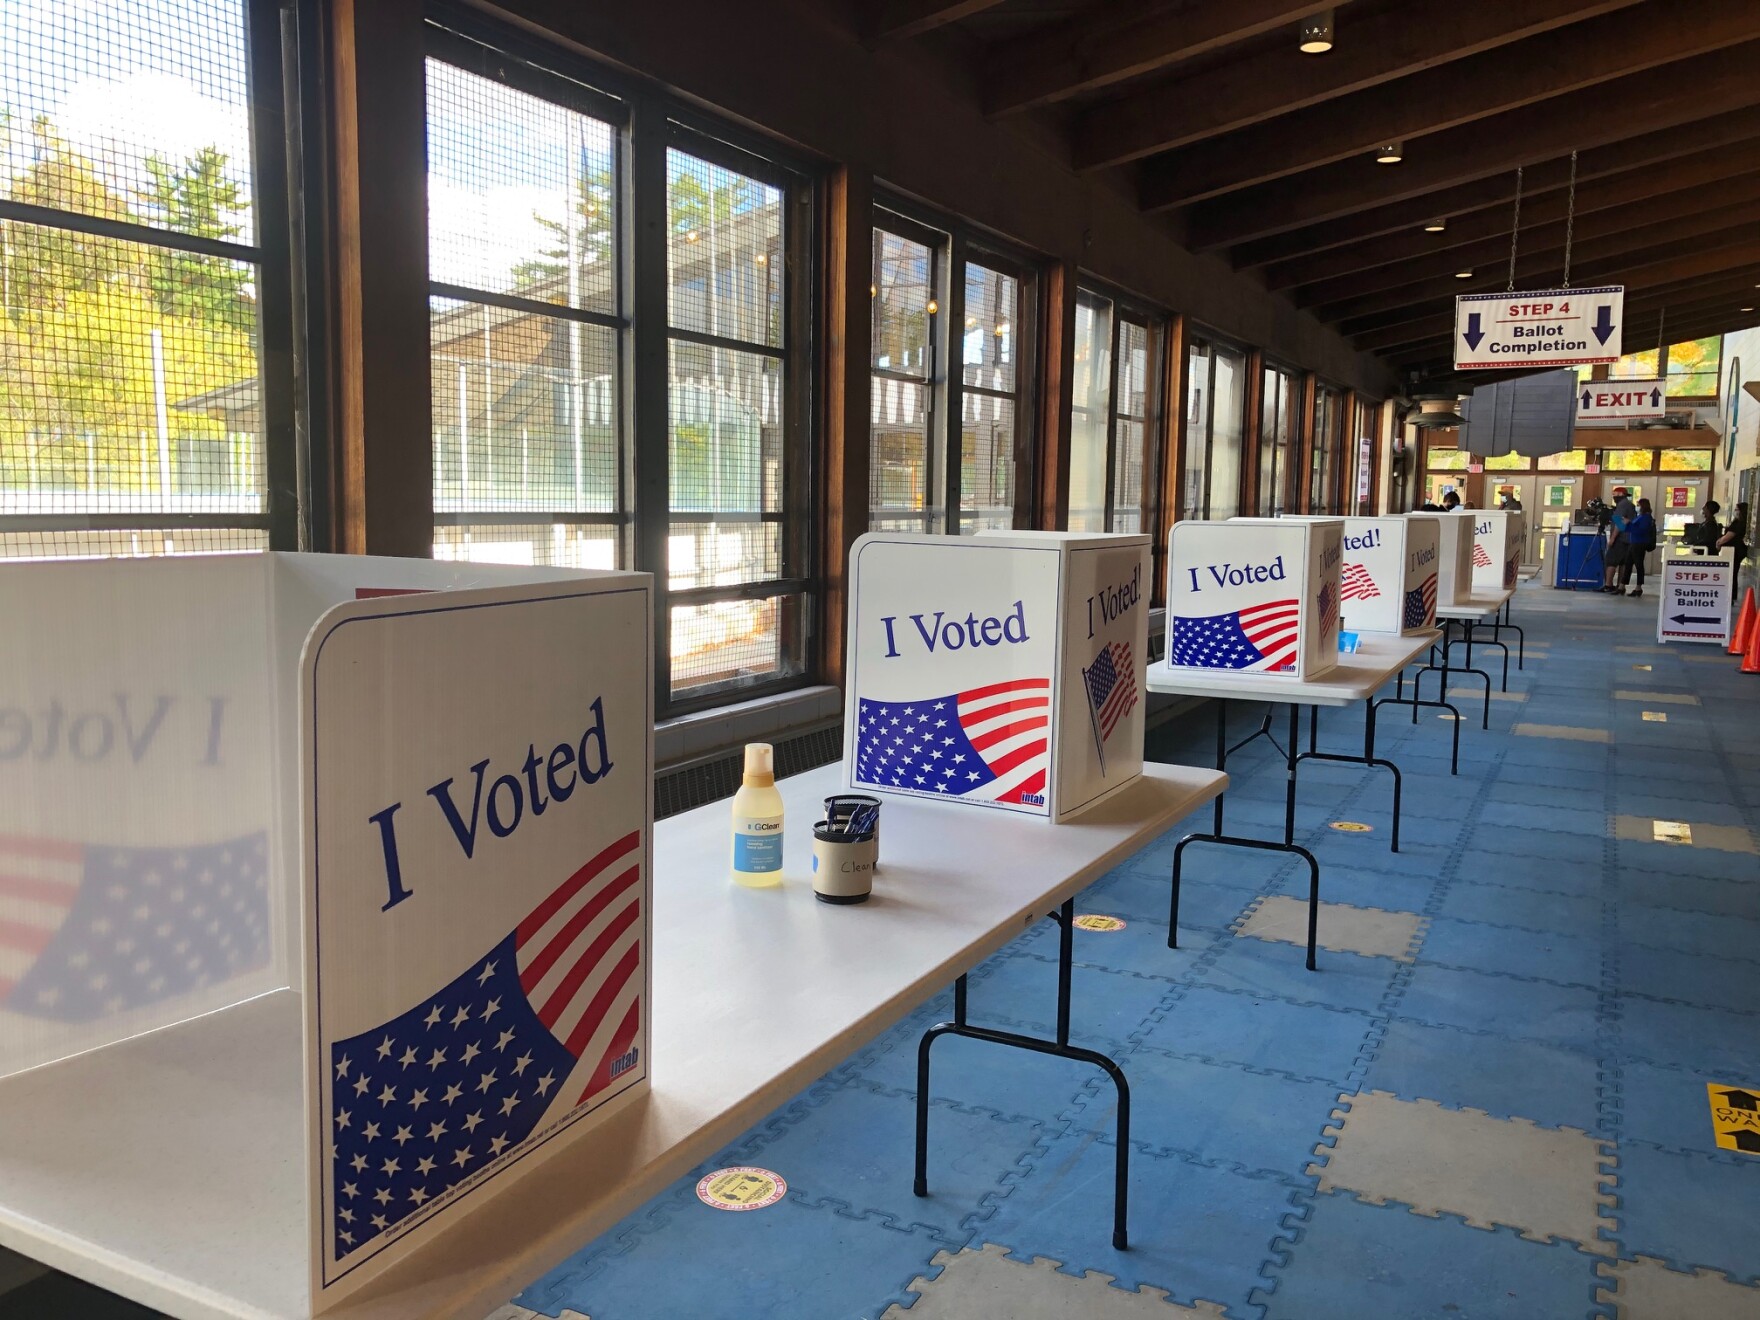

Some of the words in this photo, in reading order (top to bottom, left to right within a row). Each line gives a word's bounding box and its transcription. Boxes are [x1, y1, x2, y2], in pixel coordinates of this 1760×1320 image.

[1508, 303, 1554, 317] STEP
[1559, 302, 1570, 314] 4
[1513, 325, 1564, 337] Ballot
[1489, 339, 1587, 355] Completion
[1596, 392, 1648, 407] EXIT
[1411, 554, 1415, 572] I
[1417, 543, 1435, 566] Voted
[1188, 567, 1202, 592] I
[1207, 555, 1286, 588] Voted
[1675, 572, 1709, 581] STEP
[1713, 573, 1720, 582] 5
[1674, 588, 1719, 598] Submit
[1087, 596, 1094, 640] I
[1098, 562, 1141, 626] Voted!
[1677, 598, 1715, 607] Ballot
[880, 616, 901, 658] I
[909, 600, 1030, 653] Voted
[368, 802, 413, 912] I
[426, 696, 614, 859] Voted
[1022, 790, 1045, 805] intab
[610, 1046, 639, 1077] intab
